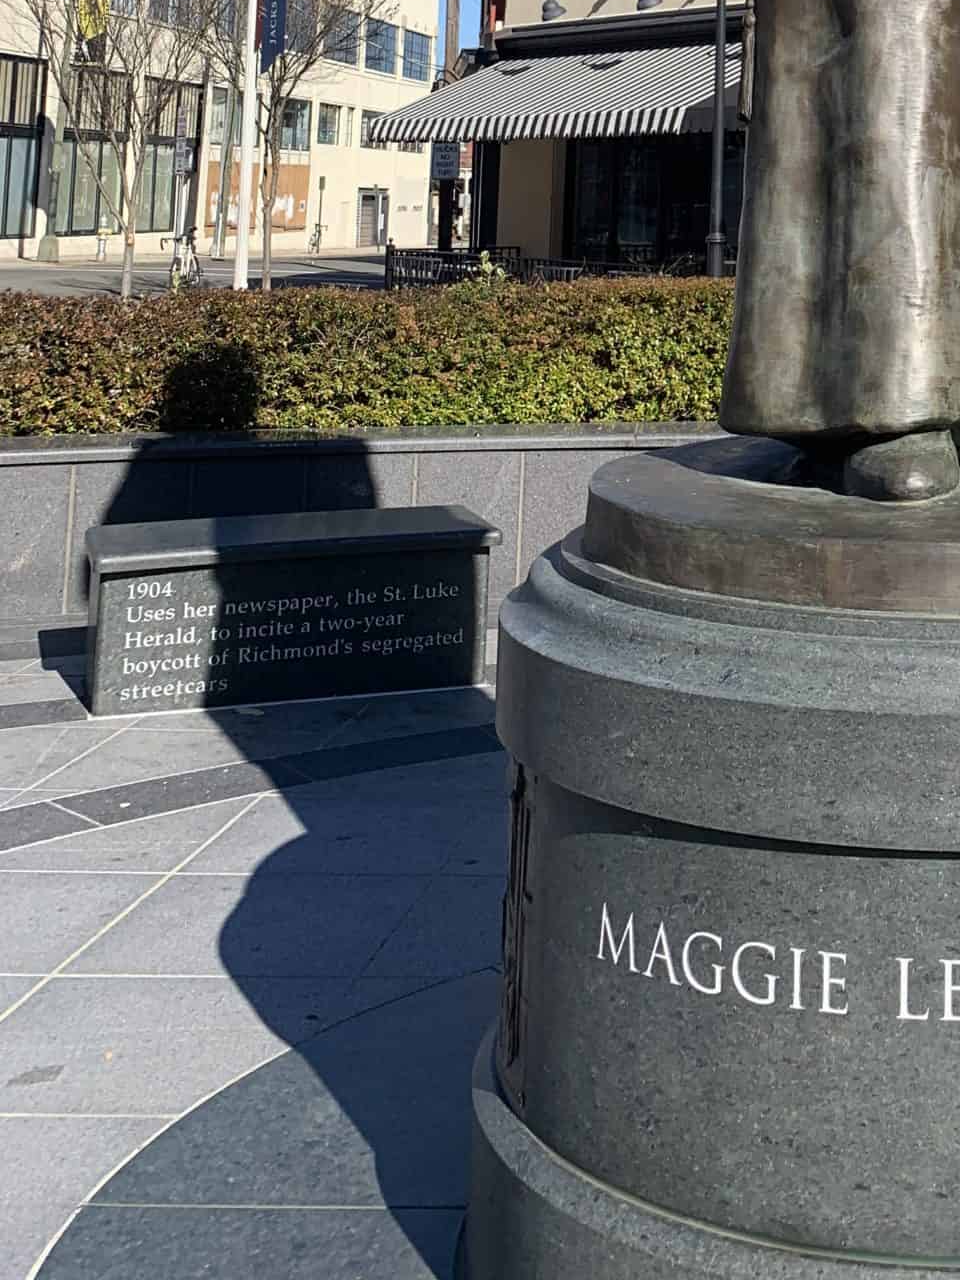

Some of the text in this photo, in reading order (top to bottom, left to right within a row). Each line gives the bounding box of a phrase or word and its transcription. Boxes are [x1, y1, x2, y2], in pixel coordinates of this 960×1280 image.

[127, 582, 460, 623] Uses her newspaper, the St. Luke
[124, 613, 405, 649] Herald, to incite a two-year
[122, 628, 465, 677] boycott of Richmond's segregated
[119, 678, 229, 701] streetcars
[596, 901, 848, 1015] MAGGIE
